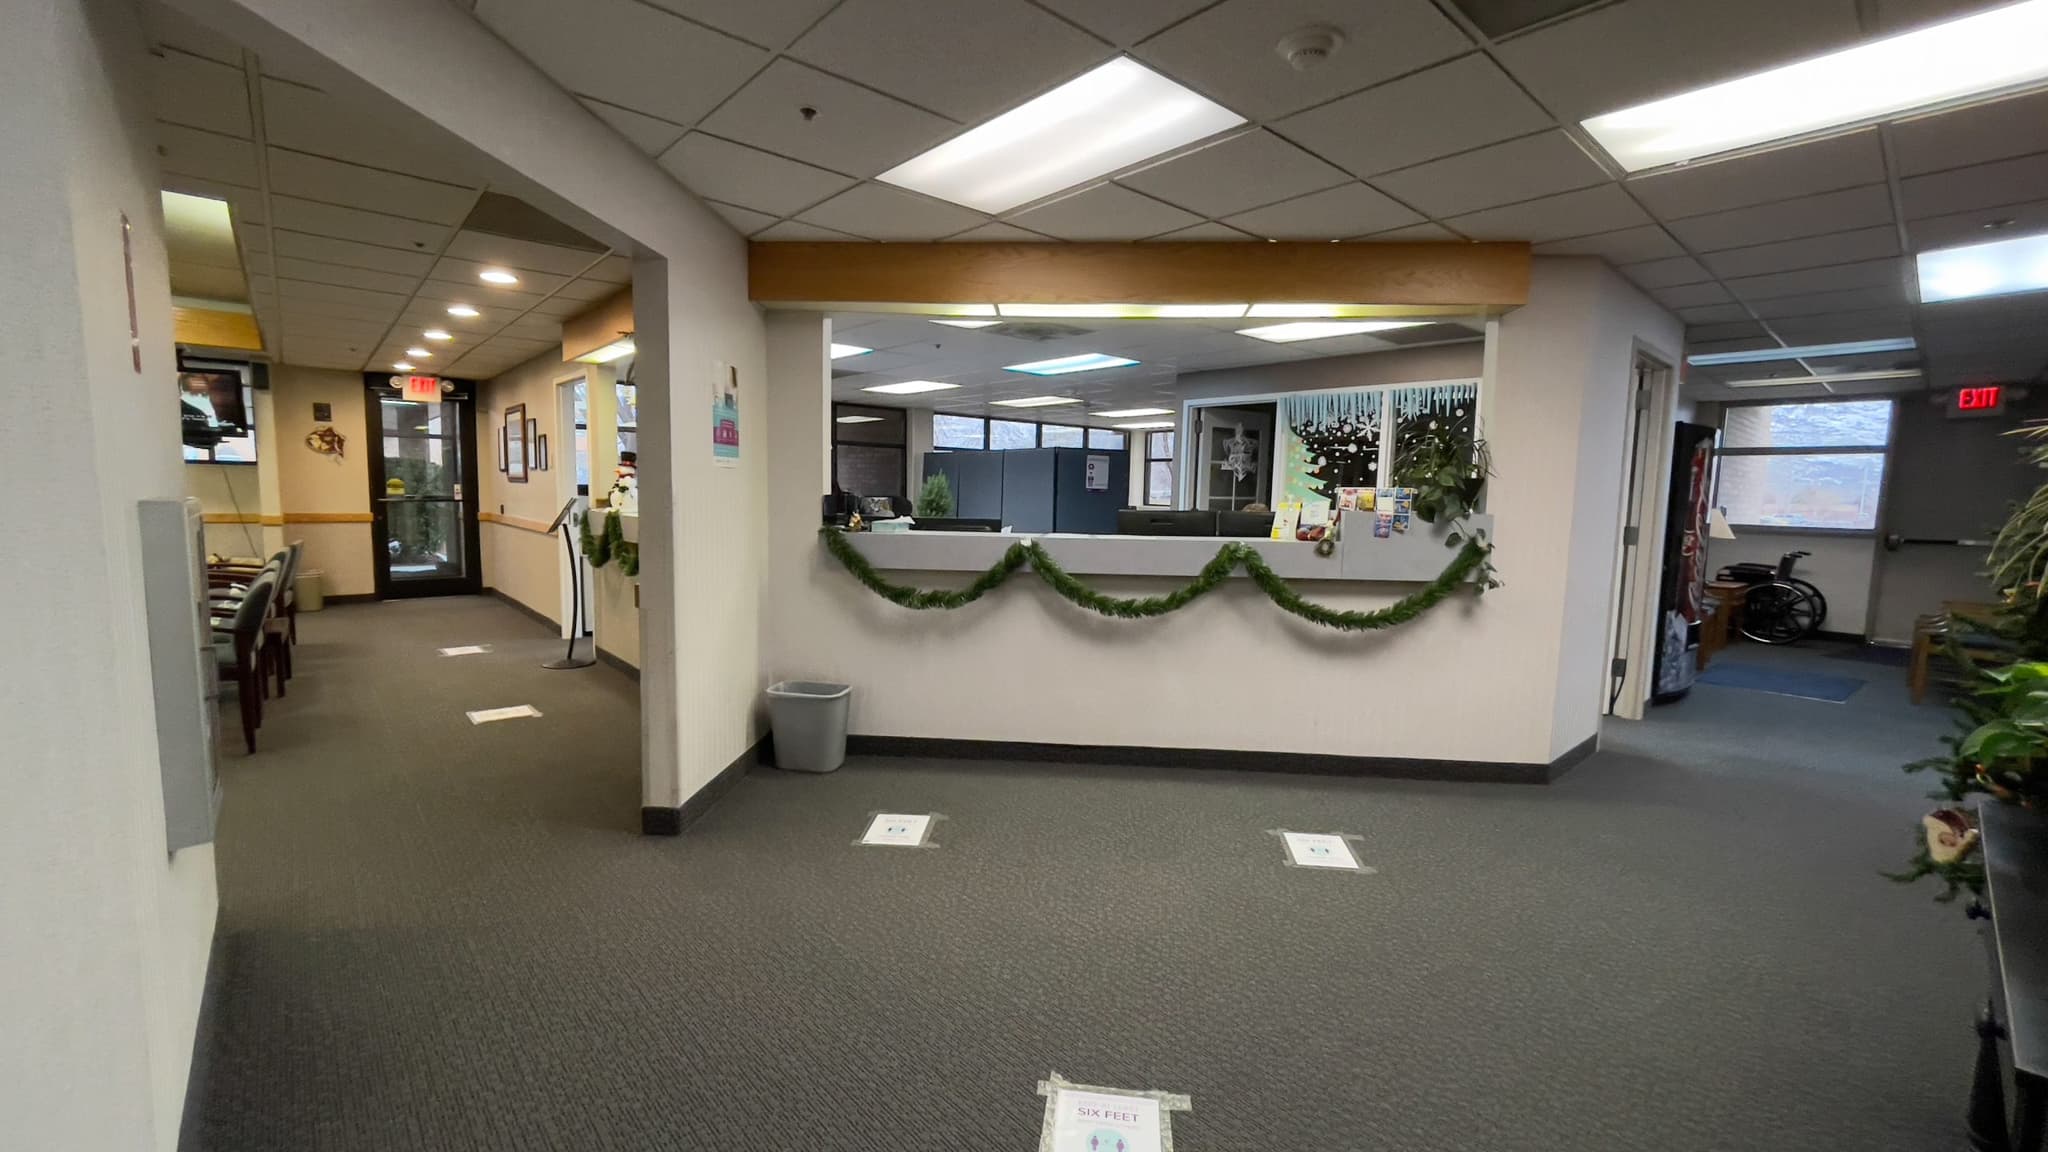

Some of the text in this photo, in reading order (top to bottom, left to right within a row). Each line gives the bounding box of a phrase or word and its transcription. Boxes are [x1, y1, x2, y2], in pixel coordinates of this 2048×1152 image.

[410, 376, 437, 393] EXIT
[1959, 386, 1999, 409] EXIT
[1078, 1107, 1139, 1122] SIX FEET
